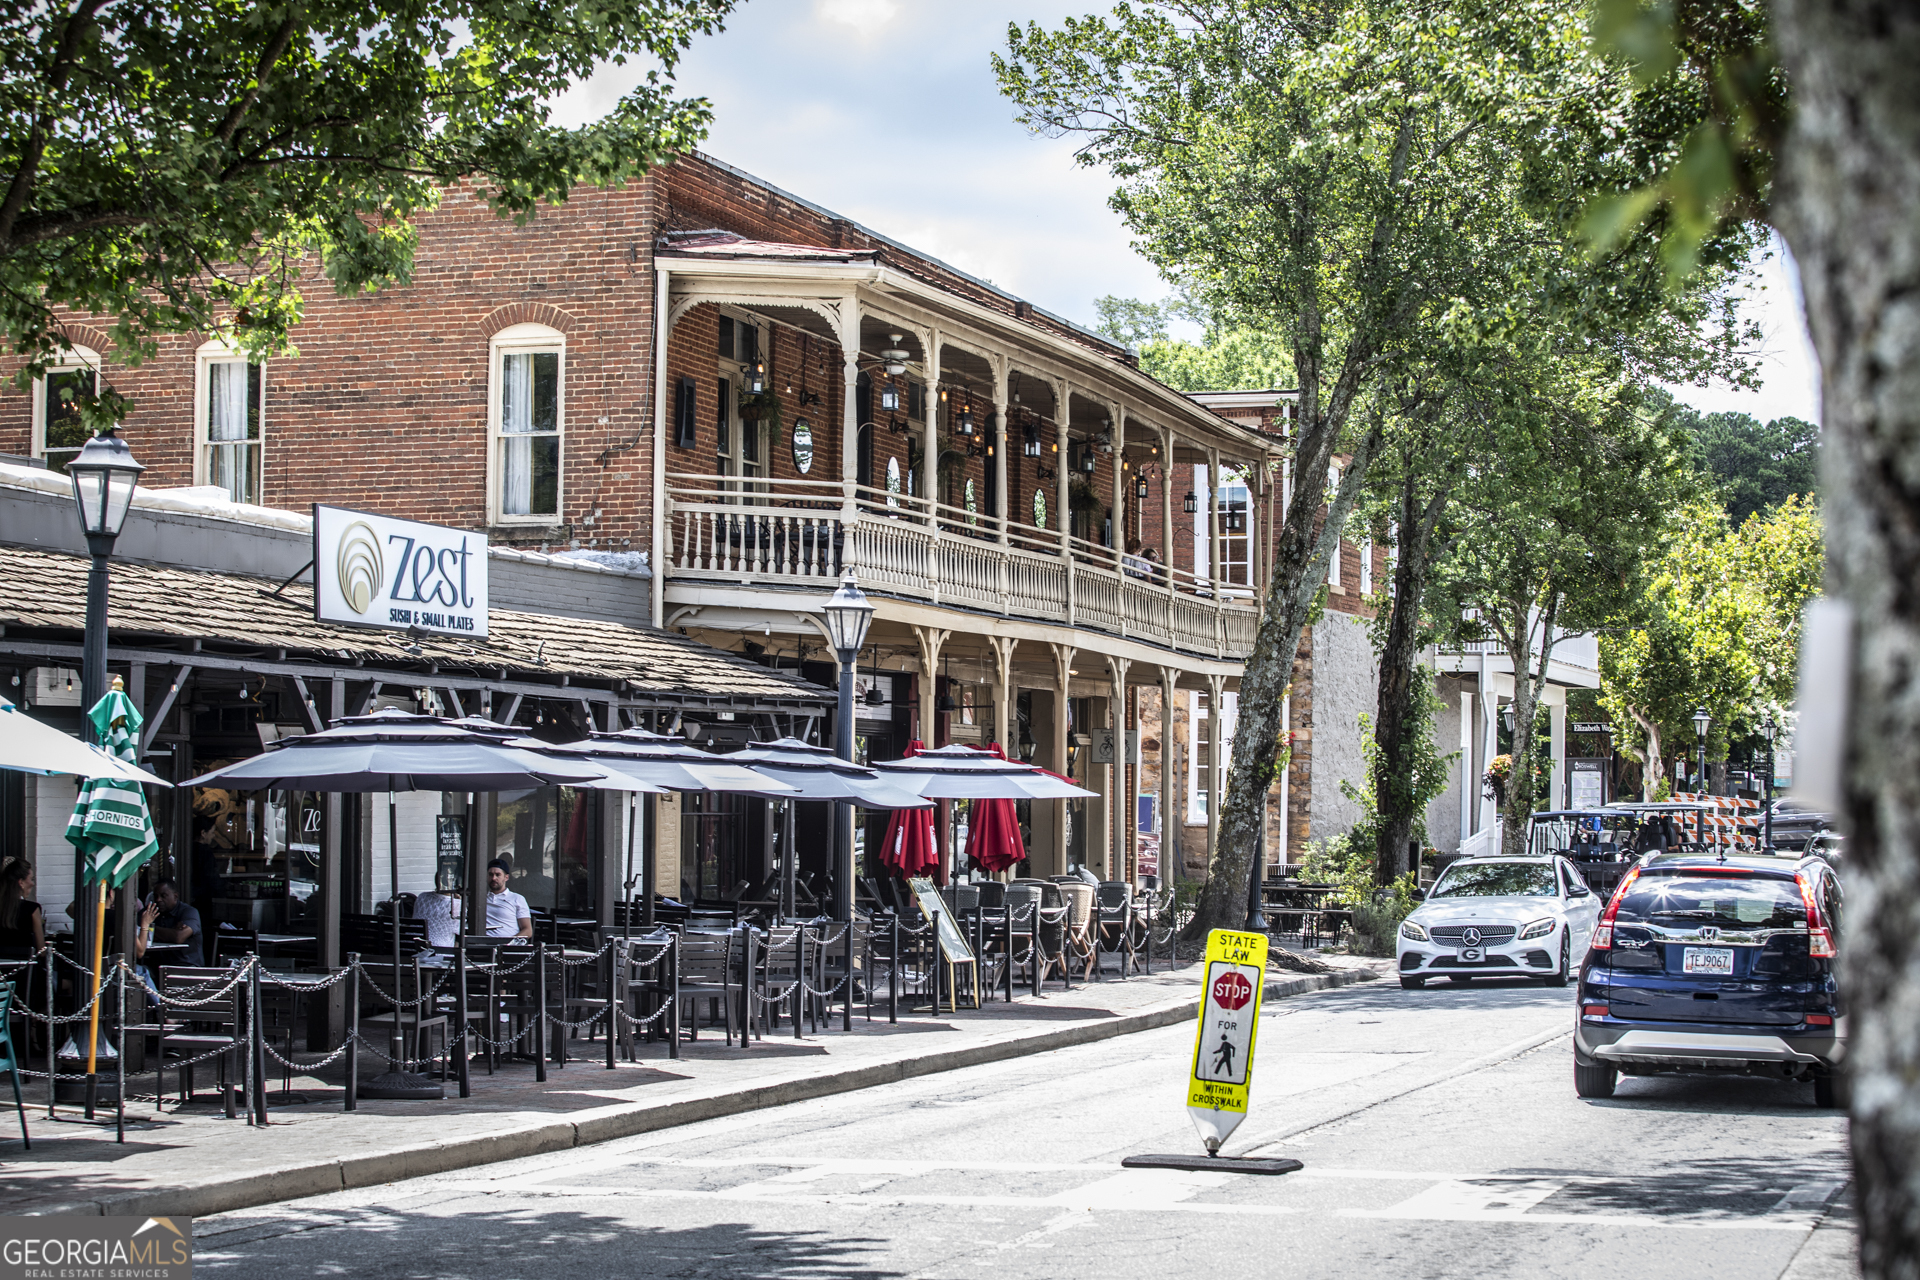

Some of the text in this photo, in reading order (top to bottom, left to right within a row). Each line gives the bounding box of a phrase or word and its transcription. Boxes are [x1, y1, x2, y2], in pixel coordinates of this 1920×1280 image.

[389, 534, 474, 608] Zest
[389, 608, 474, 630] SUSHI & SMALL PLATES
[1573, 724, 1601, 732] Elizabeth
[90, 810, 141, 828] HORNITOS
[1219, 934, 1257, 949] STATE
[1223, 948, 1250, 961] LAW
[1214, 983, 1250, 1000] STOP
[1217, 1020, 1237, 1031] FOR
[1205, 1083, 1233, 1096] WITHIN
[1192, 1093, 1242, 1108] CROSSWALK
